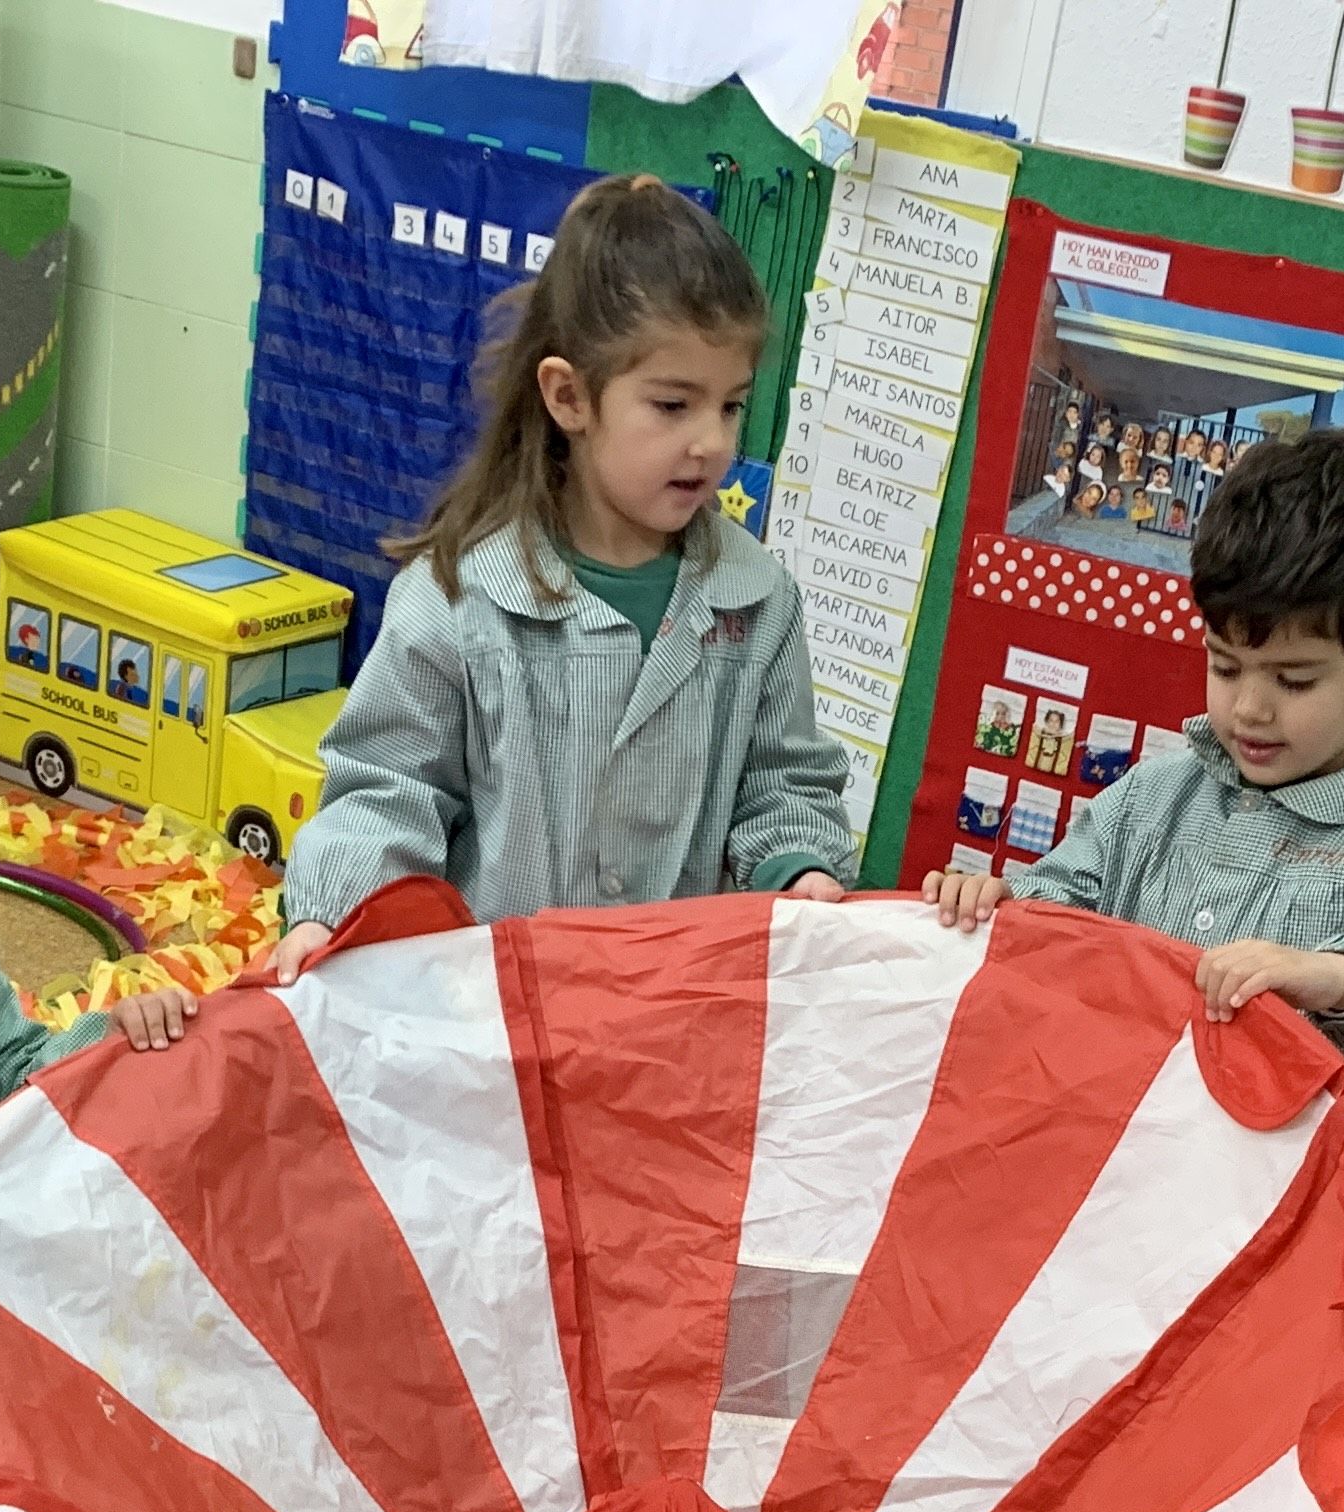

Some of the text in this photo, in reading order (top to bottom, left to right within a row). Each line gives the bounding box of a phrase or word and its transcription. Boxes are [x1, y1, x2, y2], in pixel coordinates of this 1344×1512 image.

[919, 163, 959, 188] ANA
[292, 181, 546, 265] 0 1 3 4 5 6
[842, 181, 957, 236] 2 MARTA
[838, 217, 978, 268] 3 FRANCISCO
[1062, 239, 1160, 271] HOY HAN VENIDO
[1067, 255, 1084, 268] AL
[829, 251, 974, 308] 4 MANUELA B.
[816, 293, 938, 336] 5 AITOR
[814, 323, 934, 374] 6 ISABEL
[810, 354, 957, 419] 7 MARI SANTOS
[799, 391, 925, 453] 8 MARIELA
[798, 422, 904, 471] 9 HUGO
[786, 455, 918, 511] 10 BEATRIZ
[782, 490, 890, 532] 11 CLOE
[775, 518, 908, 567] 12 MACARENA
[812, 557, 873, 589] DAVID
[877, 577, 894, 598] G.
[263, 604, 329, 633] SCHOOL BUS
[805, 588, 887, 632] MARTINA
[828, 661, 892, 701] MANUEL
[40, 686, 119, 725] SCHOOL BUS
[834, 703, 880, 732] JOSÉ
